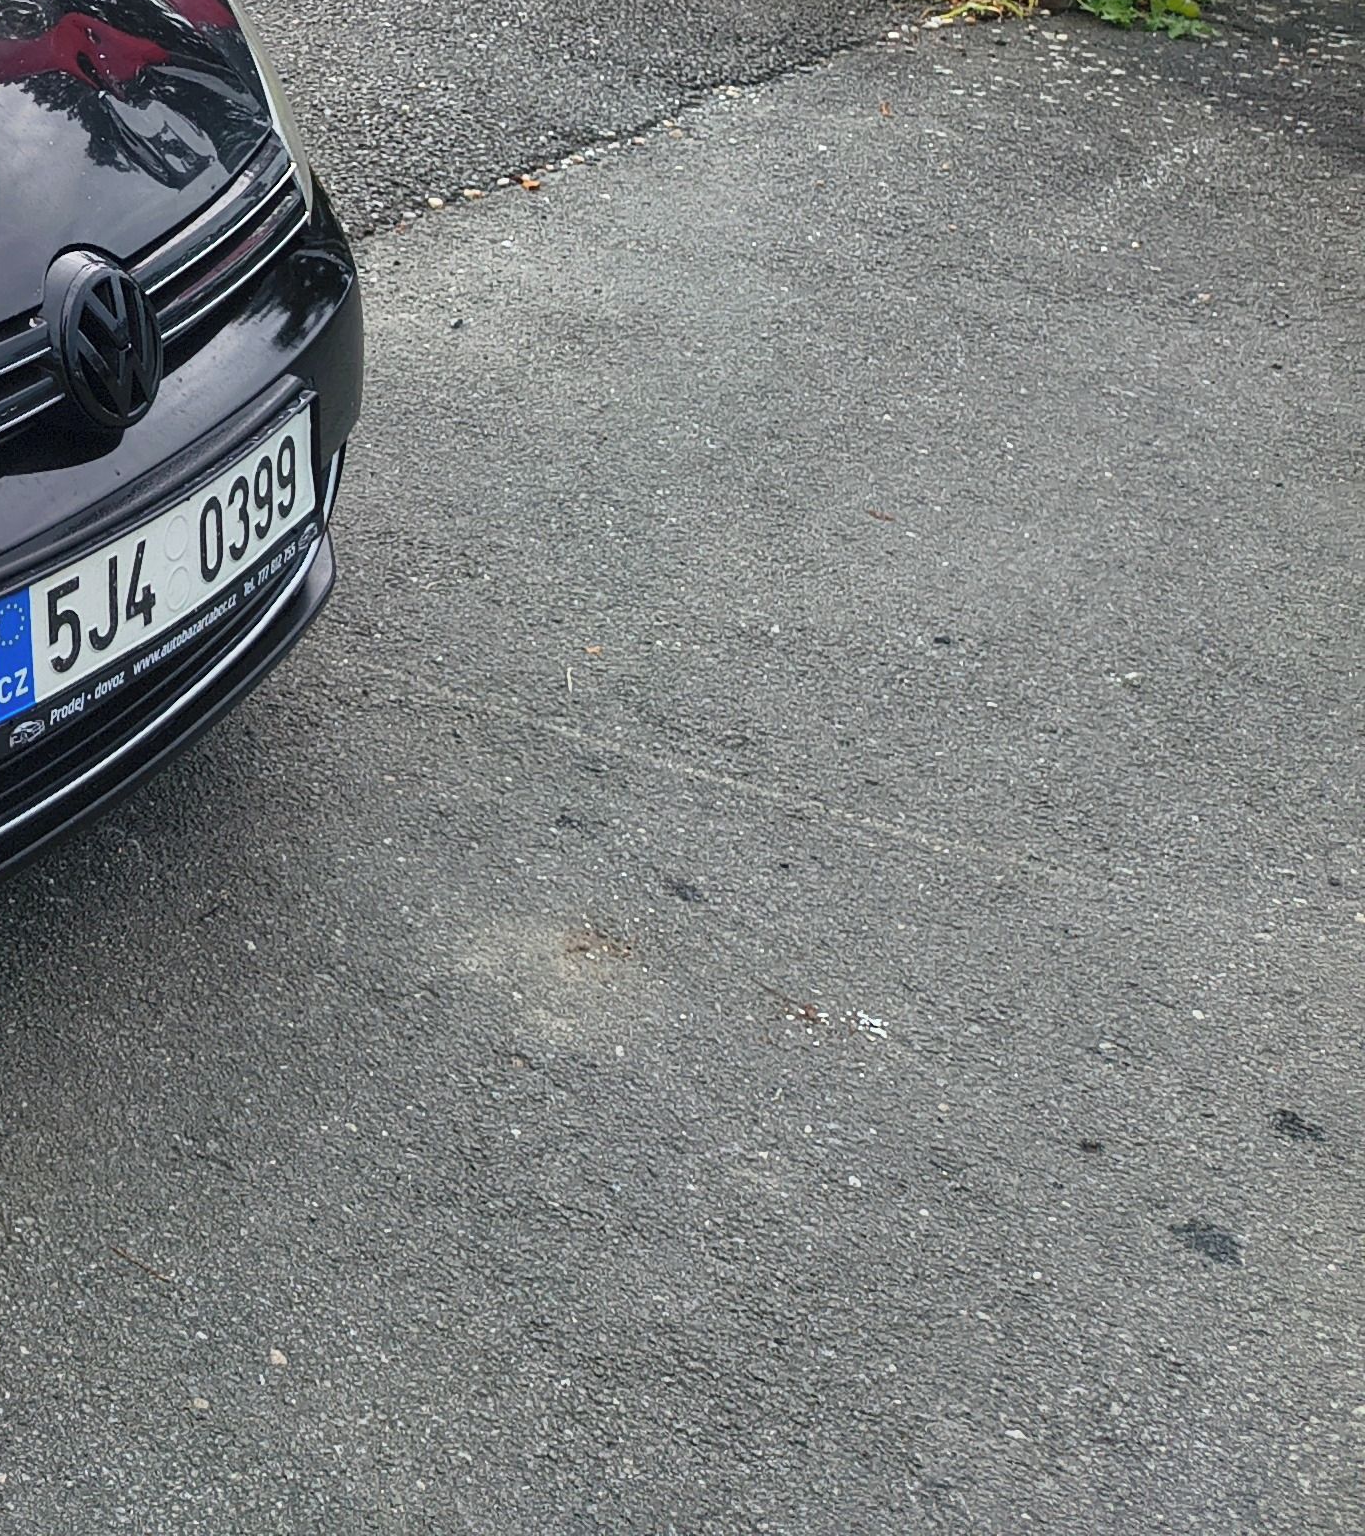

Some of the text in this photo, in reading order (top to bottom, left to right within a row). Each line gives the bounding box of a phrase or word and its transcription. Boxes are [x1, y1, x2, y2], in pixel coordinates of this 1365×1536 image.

[46, 435, 297, 674] 5J4 0399
[50, 692, 85, 725] Prodej
[94, 671, 125, 700] dovoz
